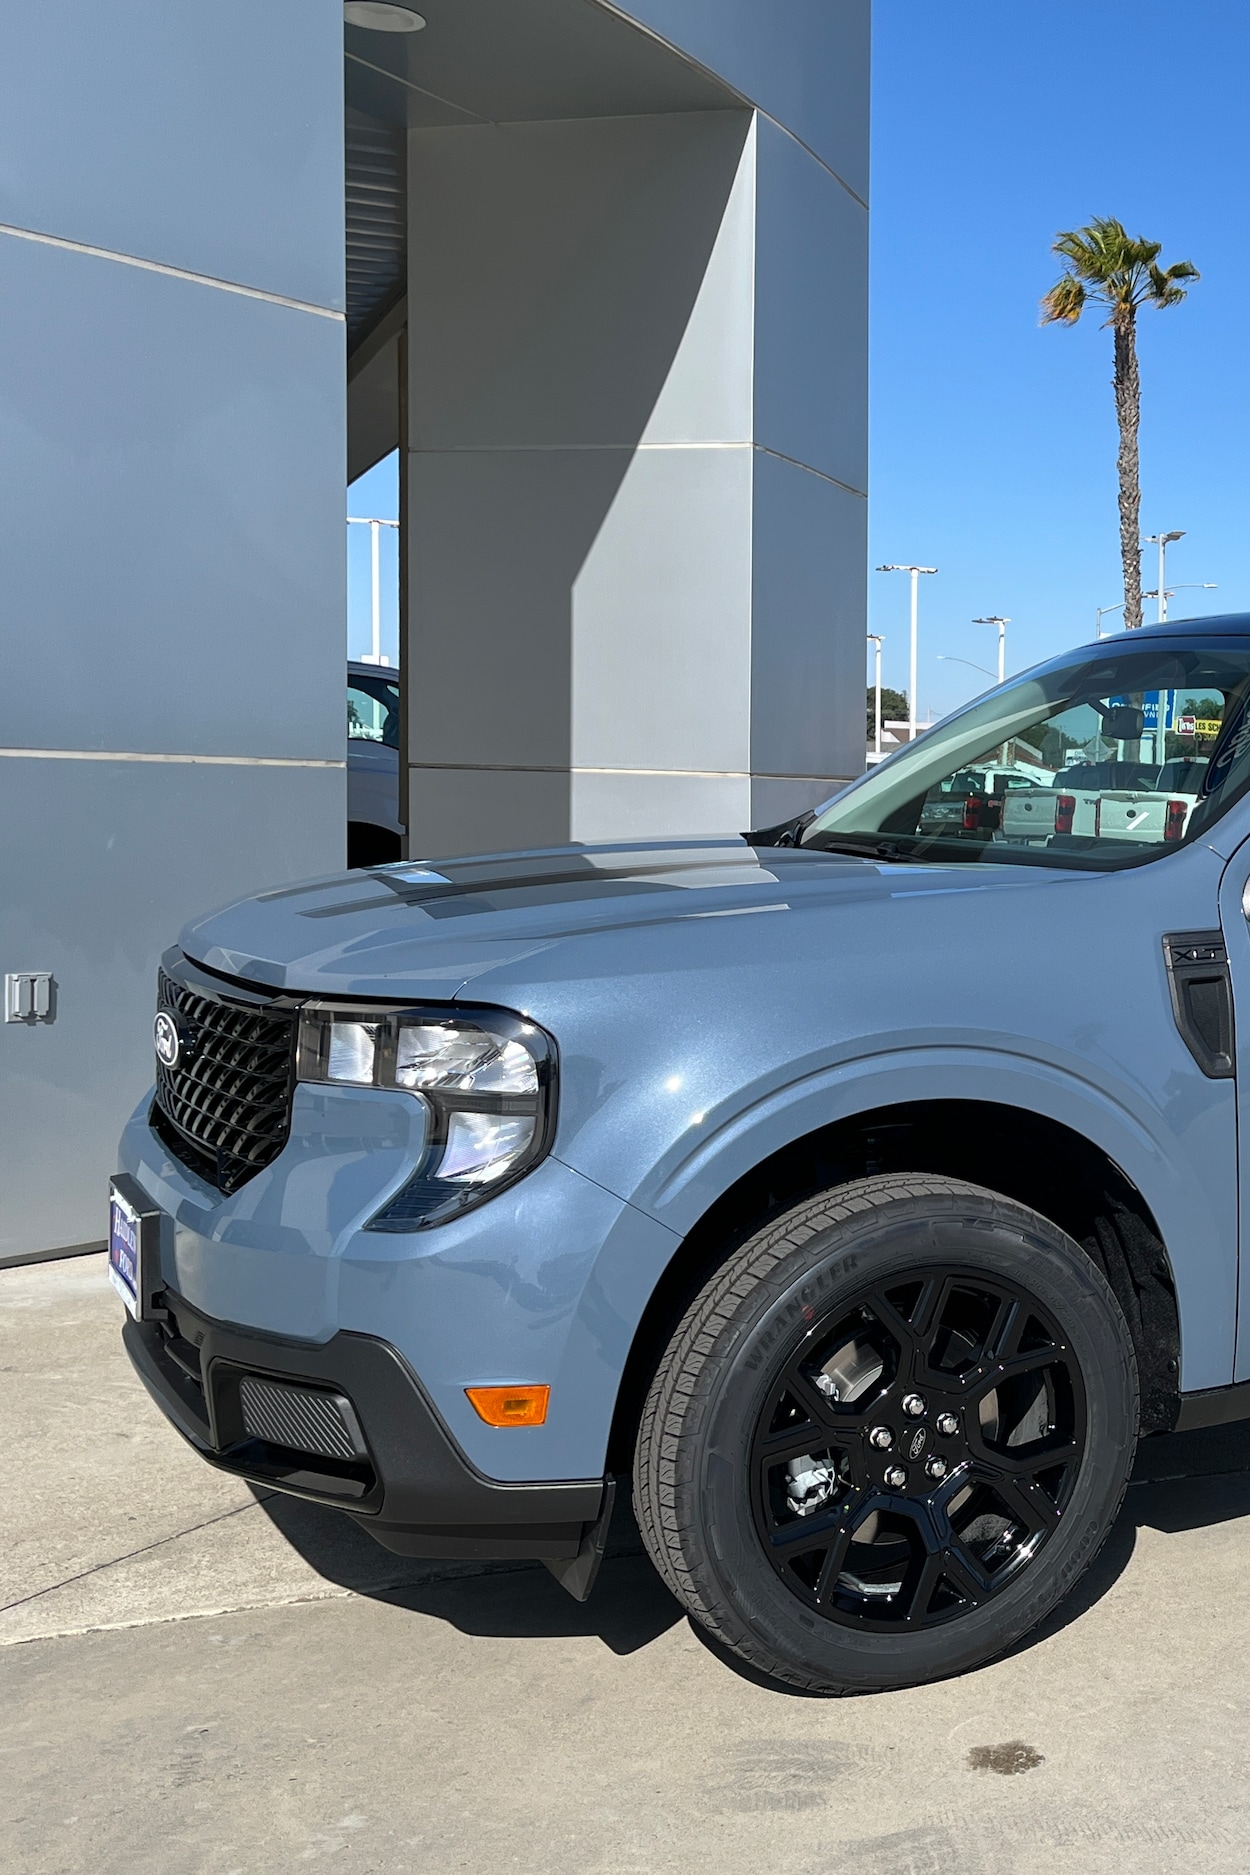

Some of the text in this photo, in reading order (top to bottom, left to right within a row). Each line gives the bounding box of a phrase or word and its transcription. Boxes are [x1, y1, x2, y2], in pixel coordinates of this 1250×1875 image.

[1195, 722, 1206, 730] LES
[1173, 947, 1223, 963] XLT
[156, 1017, 173, 1059] Ford
[744, 1253, 859, 1370] WRANGLER
[912, 1432, 925, 1456] Ford
